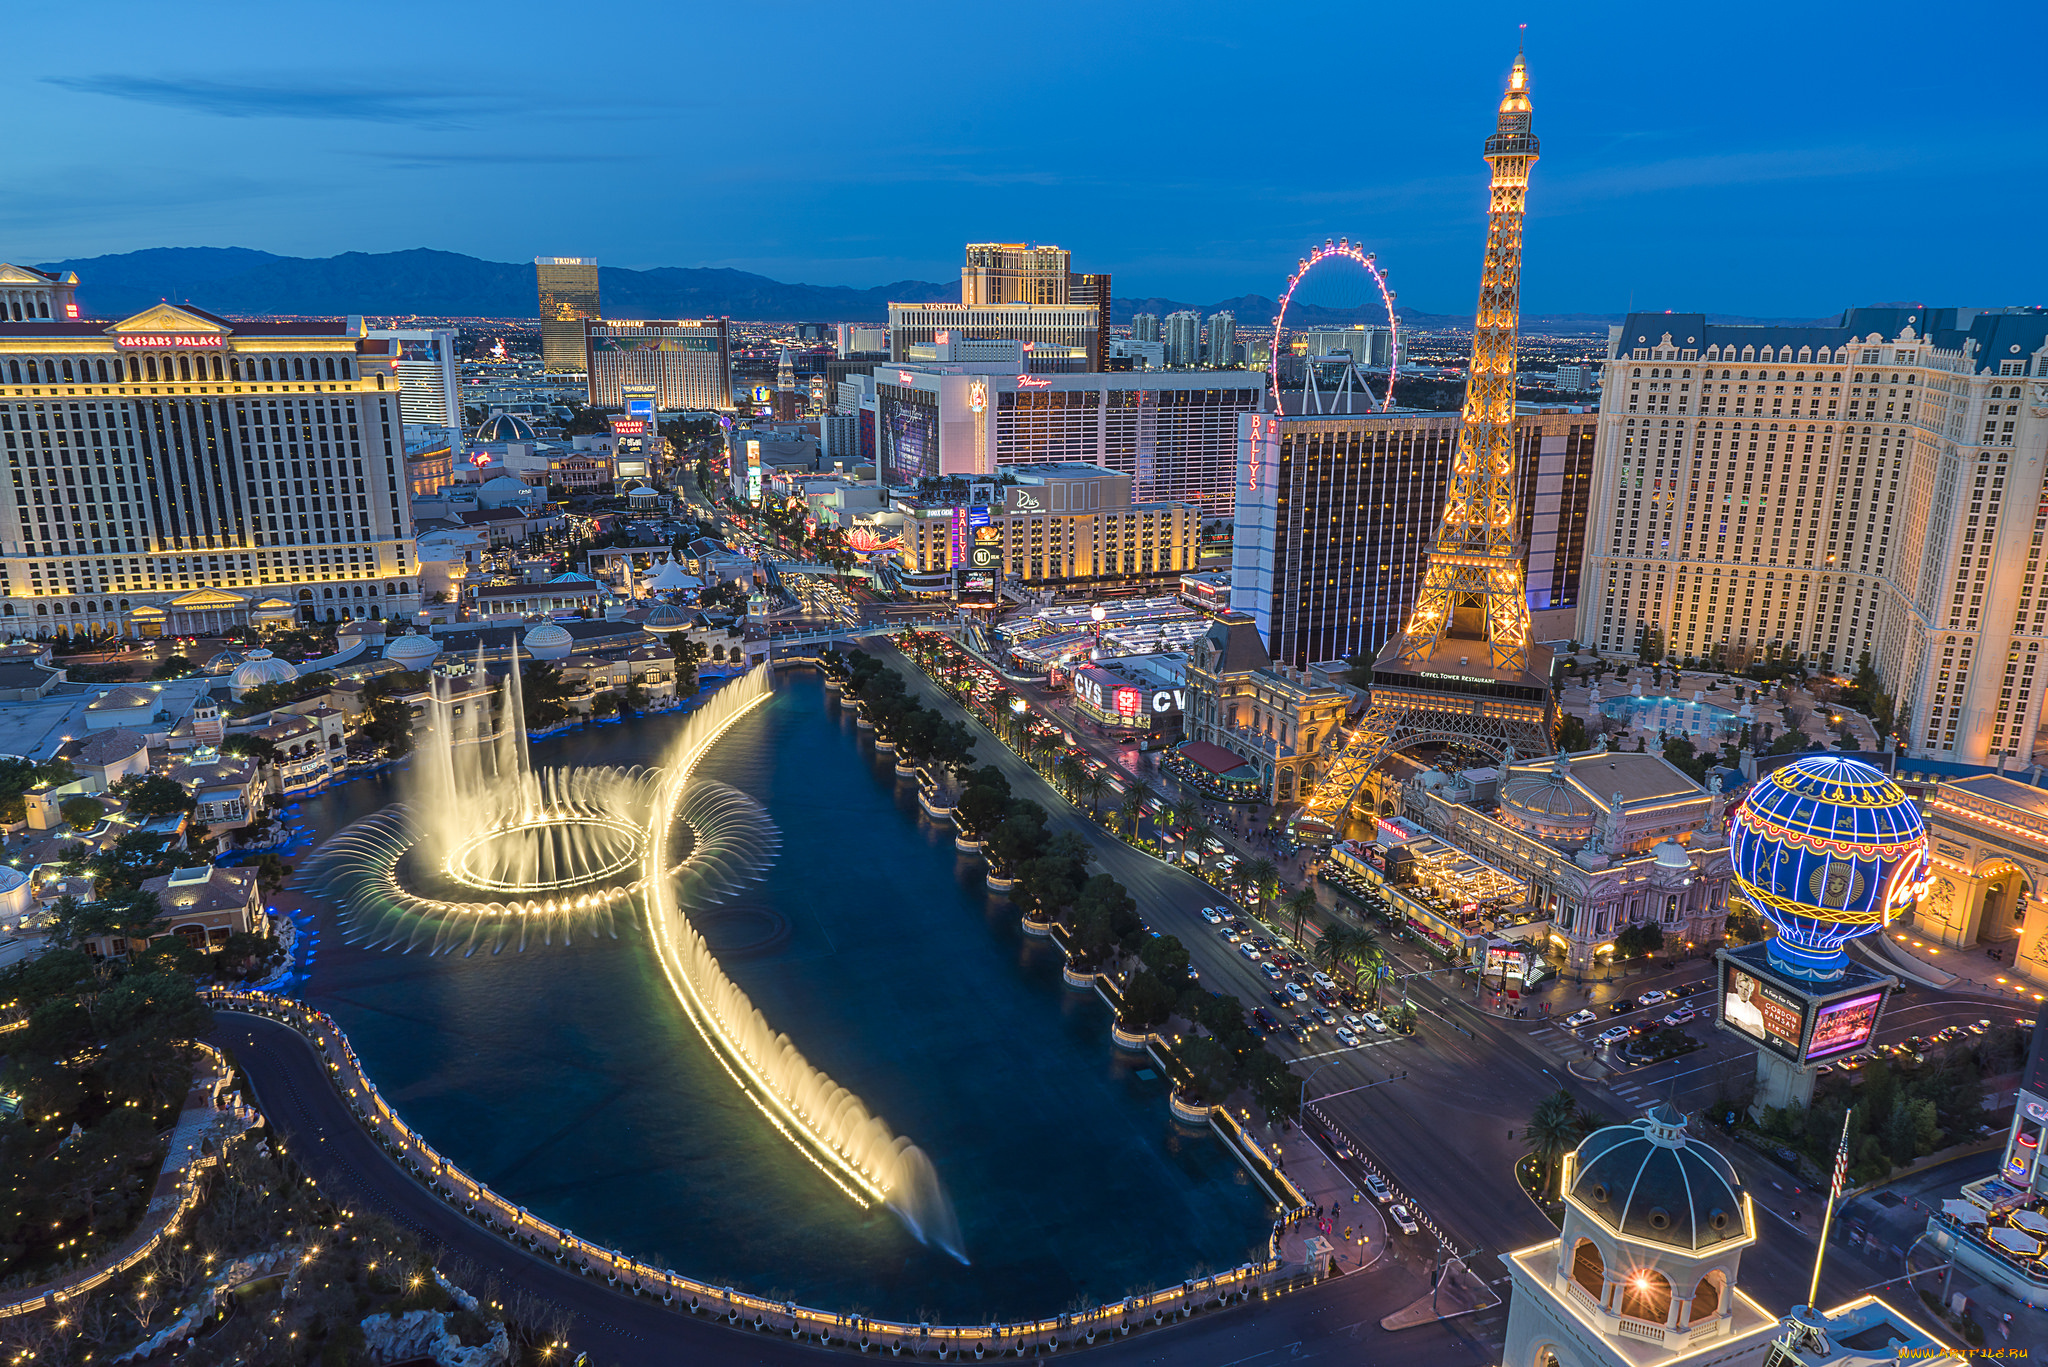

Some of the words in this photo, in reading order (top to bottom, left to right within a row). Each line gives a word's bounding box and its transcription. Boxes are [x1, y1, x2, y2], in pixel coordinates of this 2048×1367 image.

[118, 336, 172, 347] CAESARS
[175, 336, 222, 347] PALACE
[1017, 374, 1052, 389] Flamingo
[1421, 671, 1439, 679] EIFFEL
[1440, 673, 1460, 681] TOWER
[1462, 675, 1496, 684] RESTAURANT
[1075, 673, 1103, 705] CVS
[1378, 819, 1392, 832] BEER
[1392, 825, 1407, 840] PARK
[1884, 848, 1937, 927] Paris
[1764, 1009, 1796, 1030] RAMSAY
[1765, 1002, 1797, 1023] GORDON
[1820, 1010, 1869, 1030] ANTHONY
